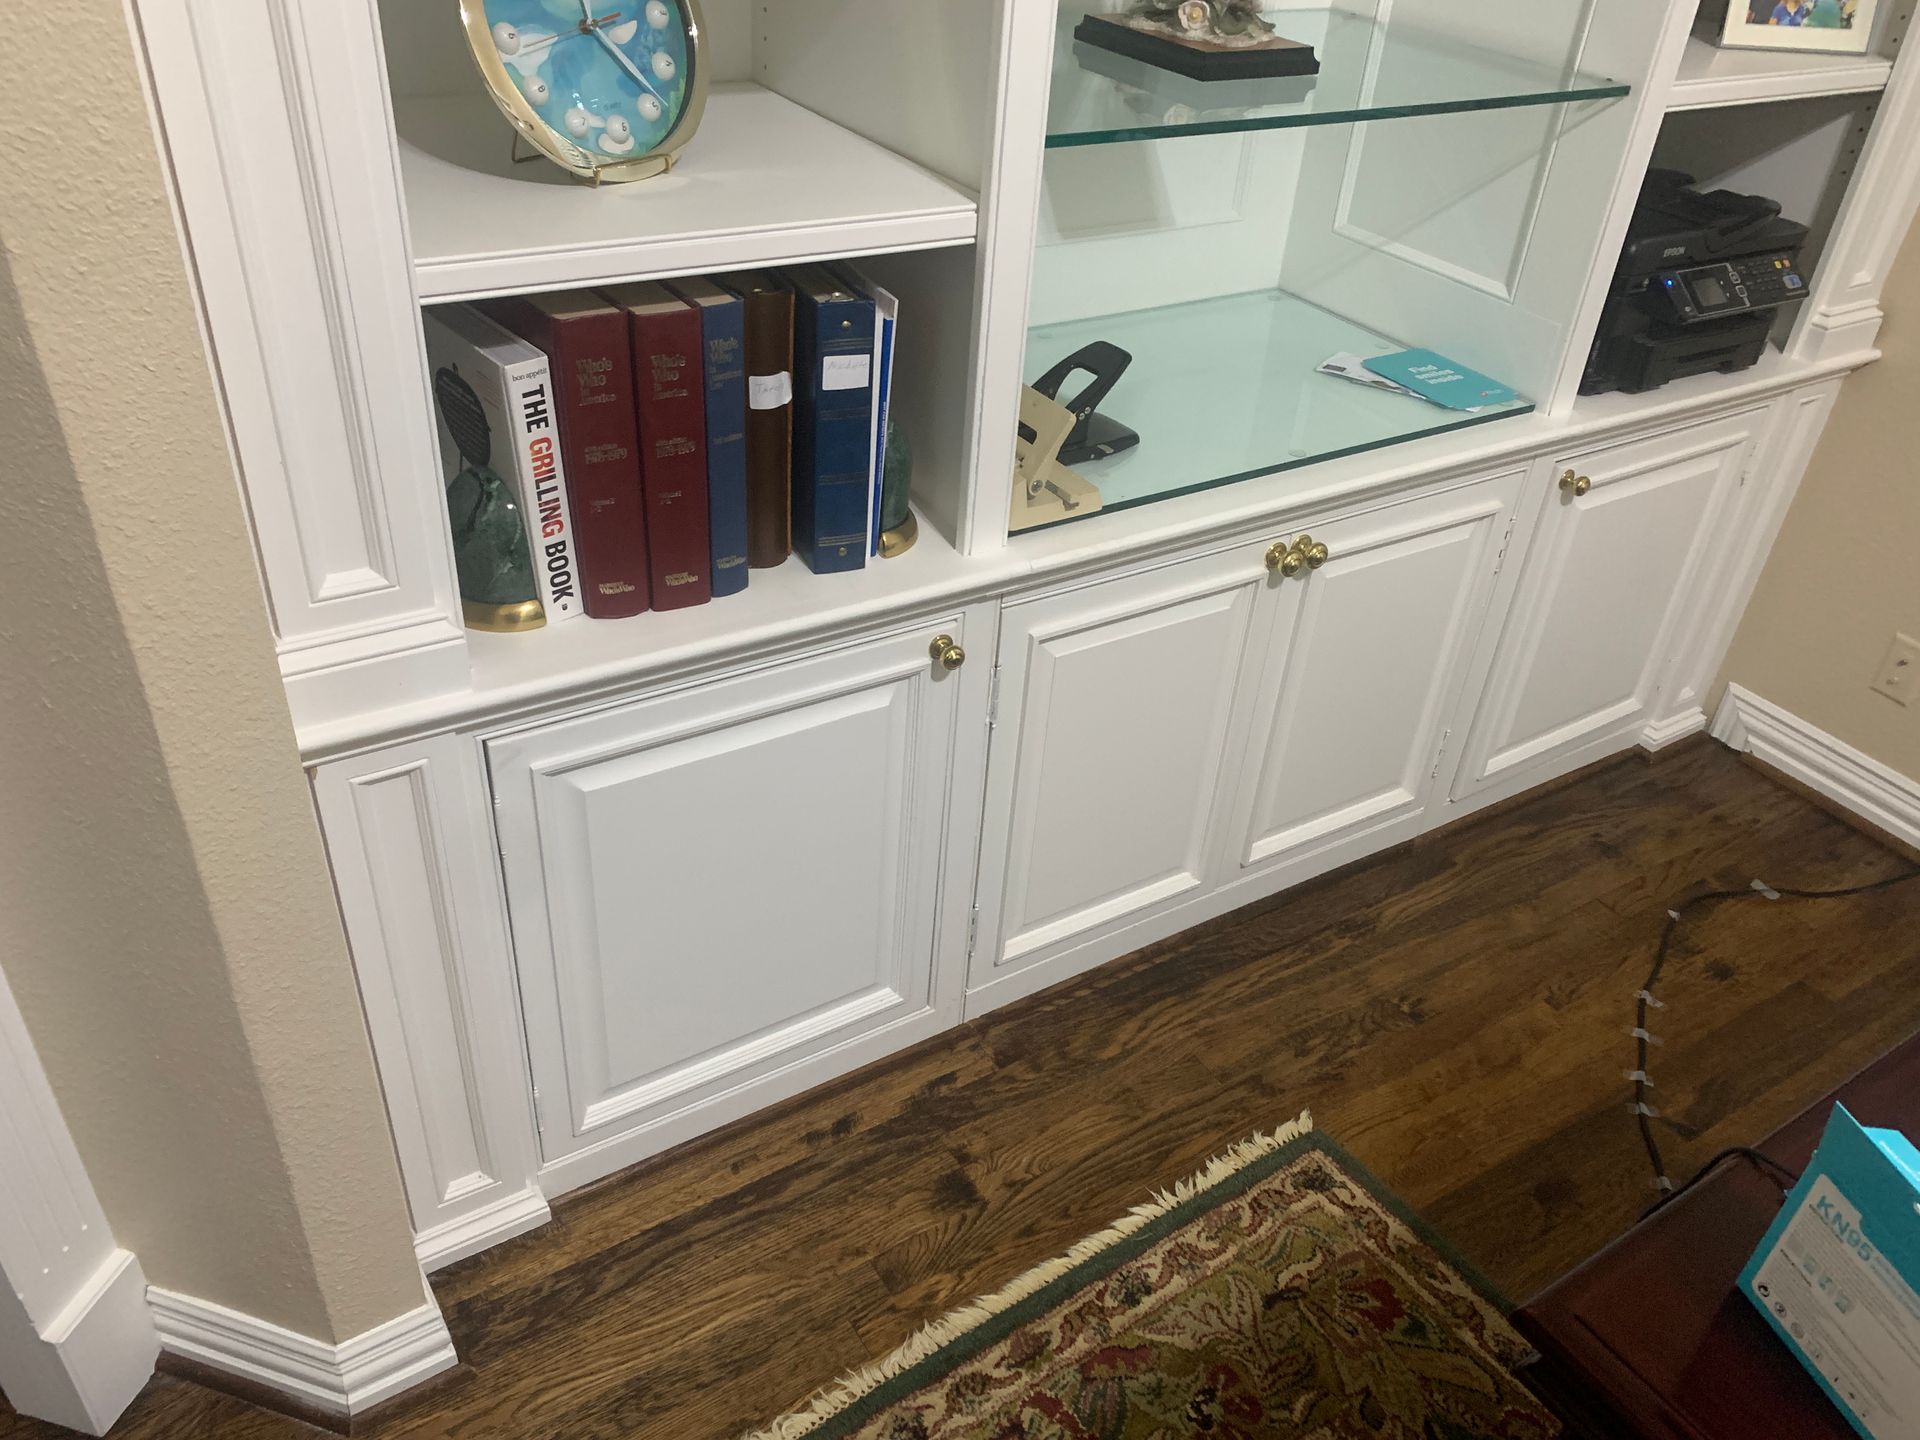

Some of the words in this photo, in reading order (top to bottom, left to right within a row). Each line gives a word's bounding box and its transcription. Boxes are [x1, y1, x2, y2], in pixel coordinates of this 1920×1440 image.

[508, 32, 517, 40] 9
[537, 84, 546, 93] 8
[651, 100, 660, 111] 5
[581, 116, 587, 126] 7
[621, 121, 628, 132] 6
[1663, 247, 1686, 257] EPSON
[575, 356, 614, 373] Who's
[511, 374, 526, 382] bon
[525, 367, 548, 380] appétit
[521, 383, 550, 434] THE
[529, 437, 565, 539] GRILLING
[544, 539, 574, 604] BOOK
[1815, 1195, 1874, 1263] KN95
